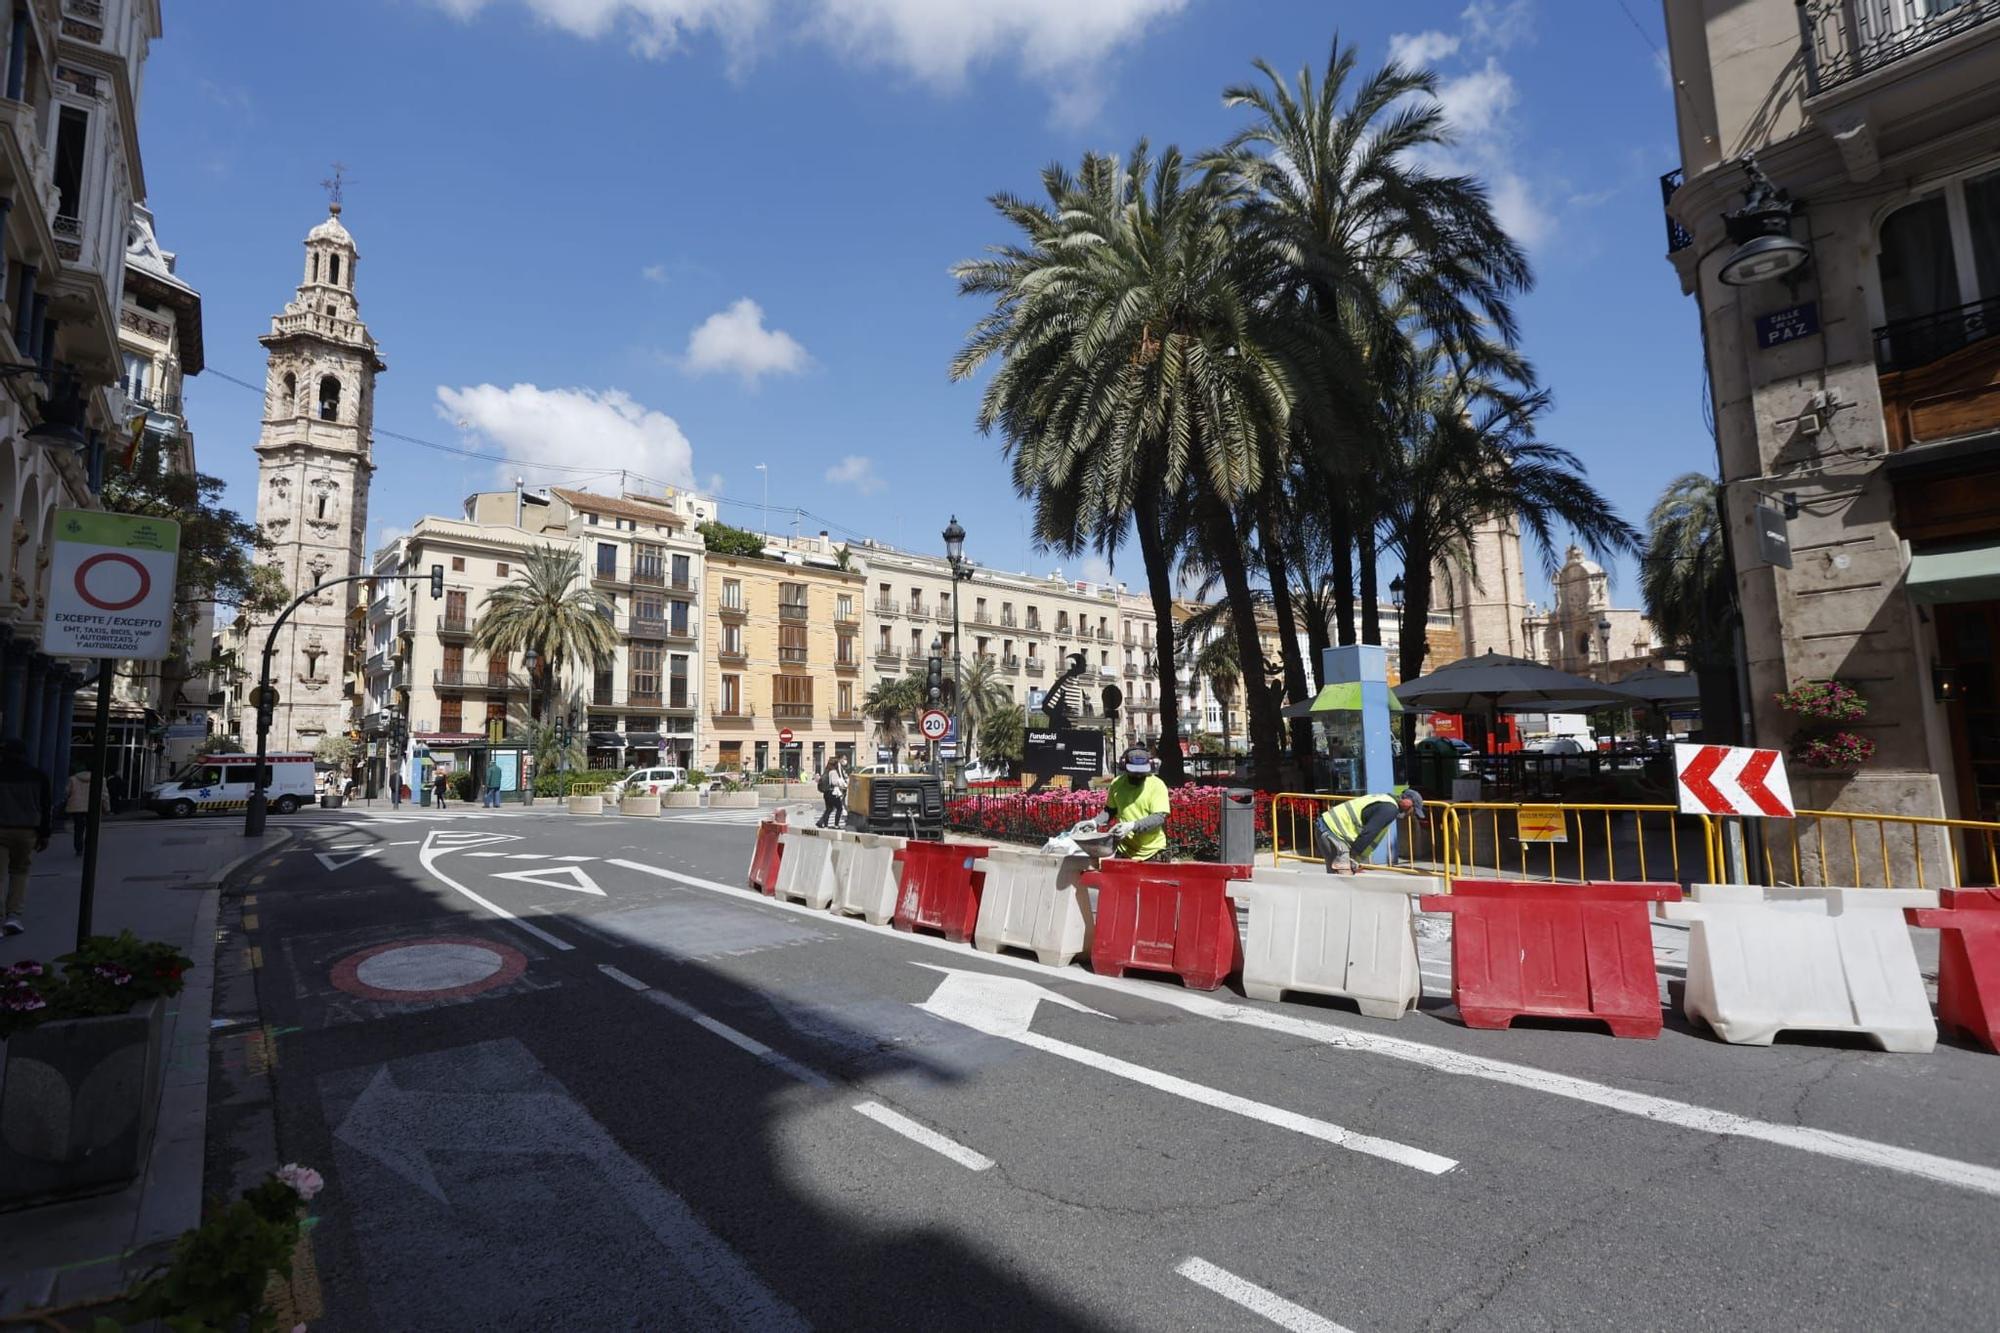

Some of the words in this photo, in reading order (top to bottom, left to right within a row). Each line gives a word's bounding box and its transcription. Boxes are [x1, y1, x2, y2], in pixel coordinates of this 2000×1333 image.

[1770, 309, 1800, 323] CALLE
[1768, 322, 1808, 344] PAZ
[55, 613, 105, 625] EXCEPTE
[113, 617, 162, 628] EXCEPTO
[63, 626, 82, 634] EMT,
[84, 626, 108, 635] TAXIS,
[79, 634, 134, 643] AUTORITZATS
[82, 642, 138, 651] AUTORIZADOS
[1034, 693, 1043, 704] P
[1029, 732, 1057, 741] Fundació
